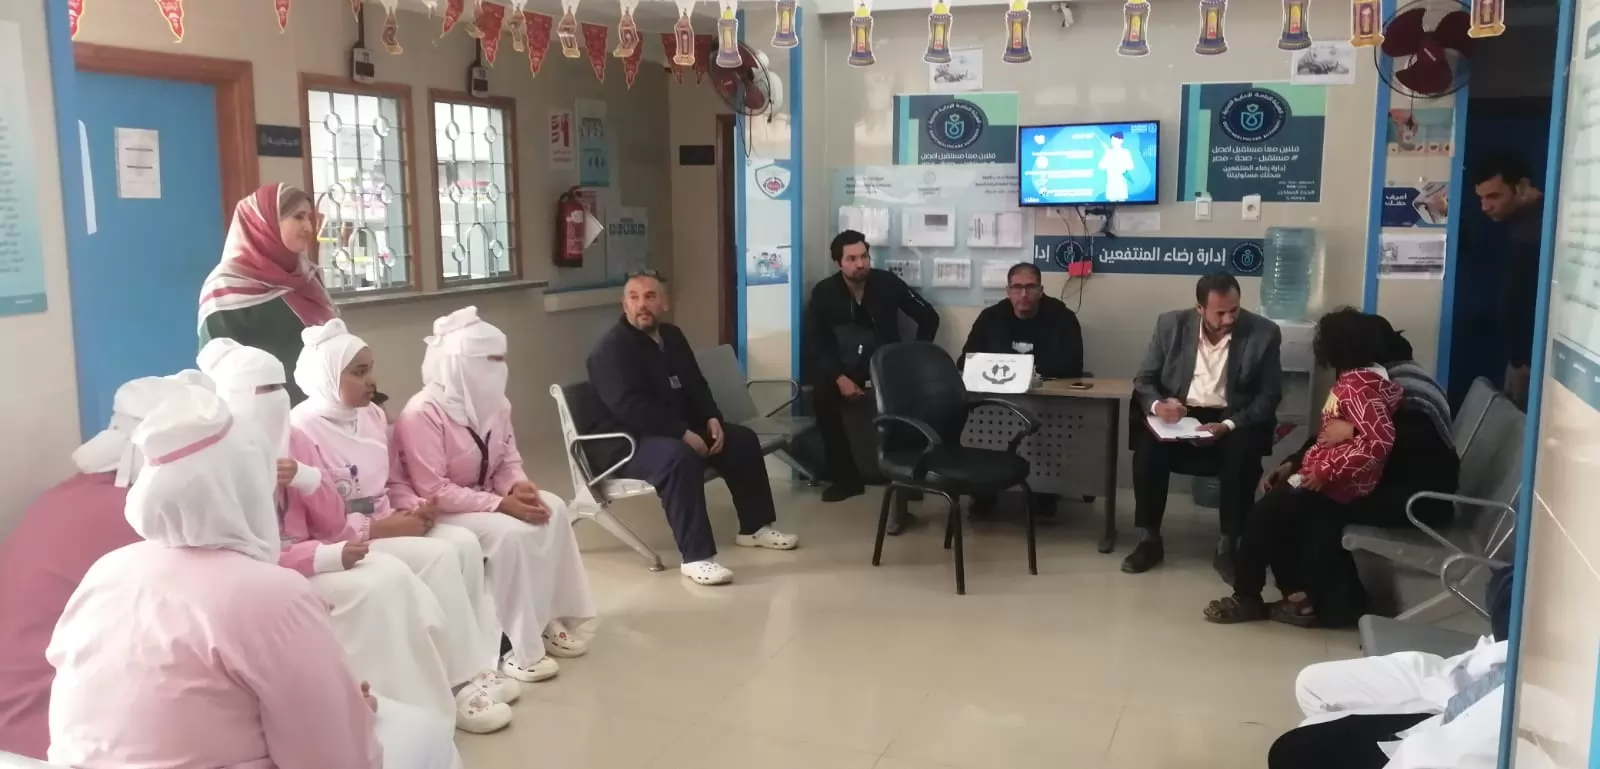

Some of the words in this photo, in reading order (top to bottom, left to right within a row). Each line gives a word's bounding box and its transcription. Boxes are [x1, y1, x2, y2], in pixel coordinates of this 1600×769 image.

[1232, 145, 1263, 154] مستقبل
[1212, 155, 1228, 163] مصر
[1234, 154, 1253, 162] صحة
[1258, 154, 1290, 162] مستقبل
[1099, 247, 1160, 264] المنتفعين
[1163, 247, 1194, 265] رضاء
[1197, 247, 1227, 266] إدارة
